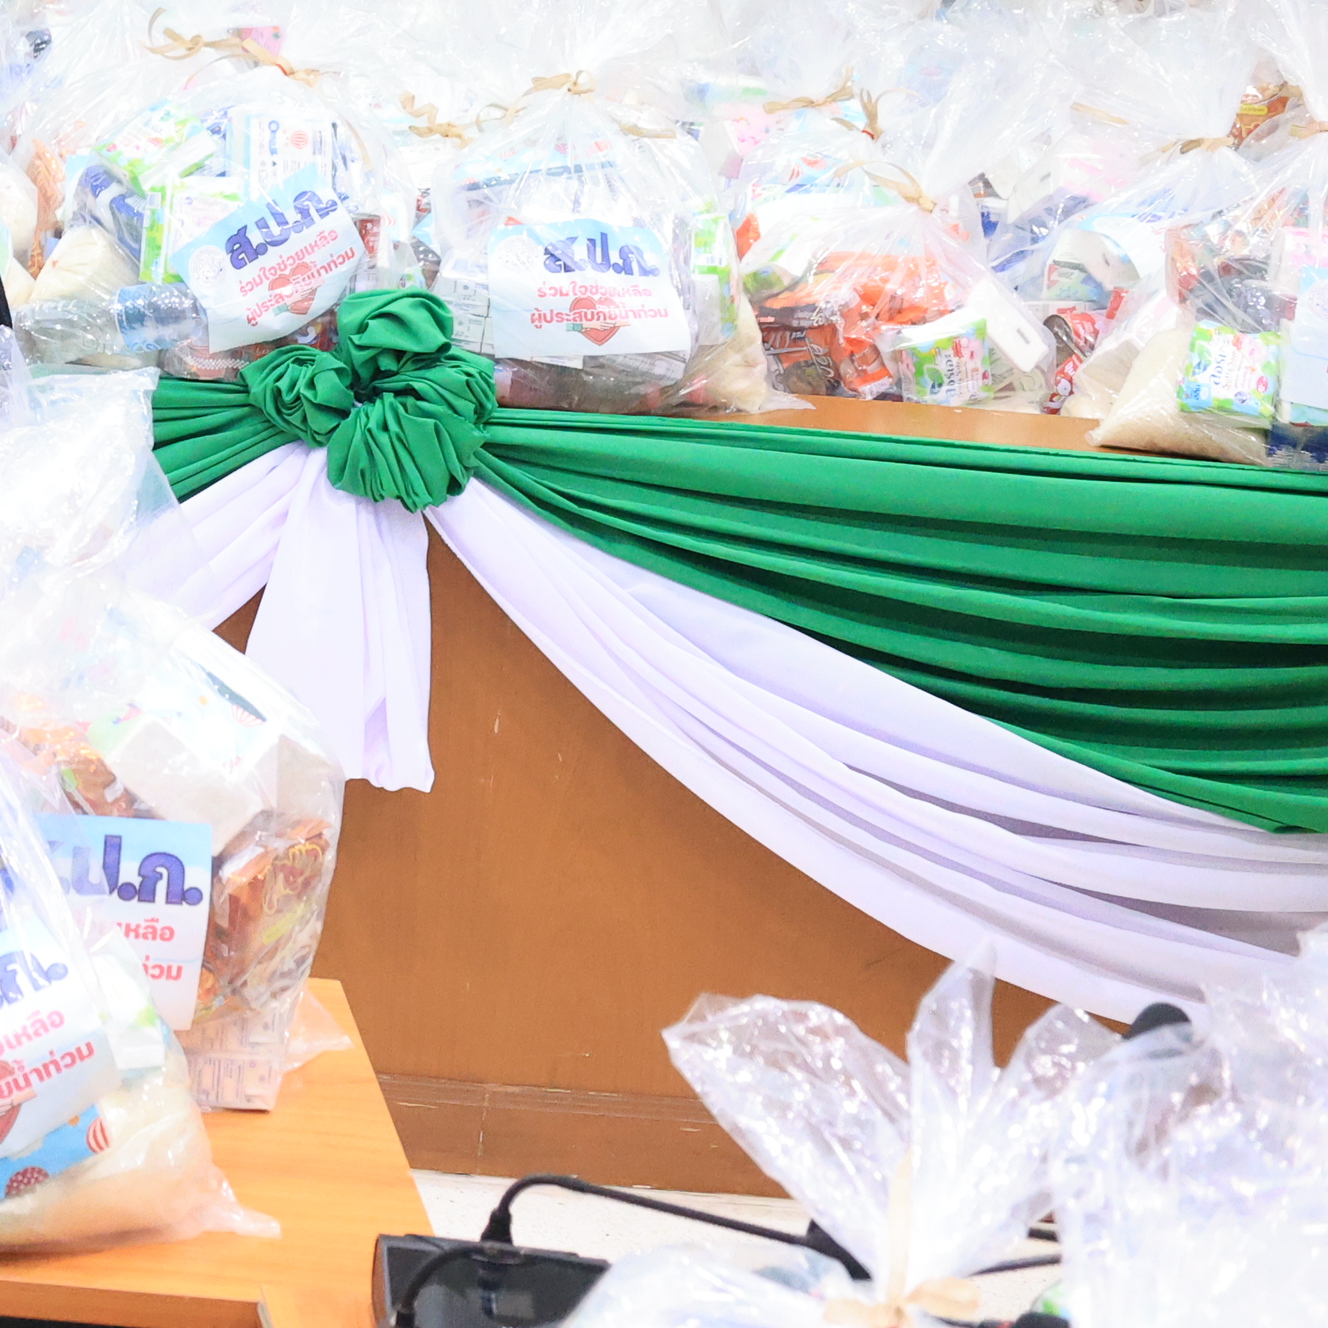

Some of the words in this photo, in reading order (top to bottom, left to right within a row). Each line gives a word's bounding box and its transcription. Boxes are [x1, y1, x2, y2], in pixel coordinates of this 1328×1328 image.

[225, 190, 338, 270] ส.ป.ก.
[239, 229, 339, 297] ร่วมใจช่วยเหลือ
[544, 231, 660, 276] ส.ป.ก.
[537, 281, 653, 299] ร่วมใจช่วยเหลือ
[530, 303, 669, 330] ผู้ประสบภัยน้ำท่วม
